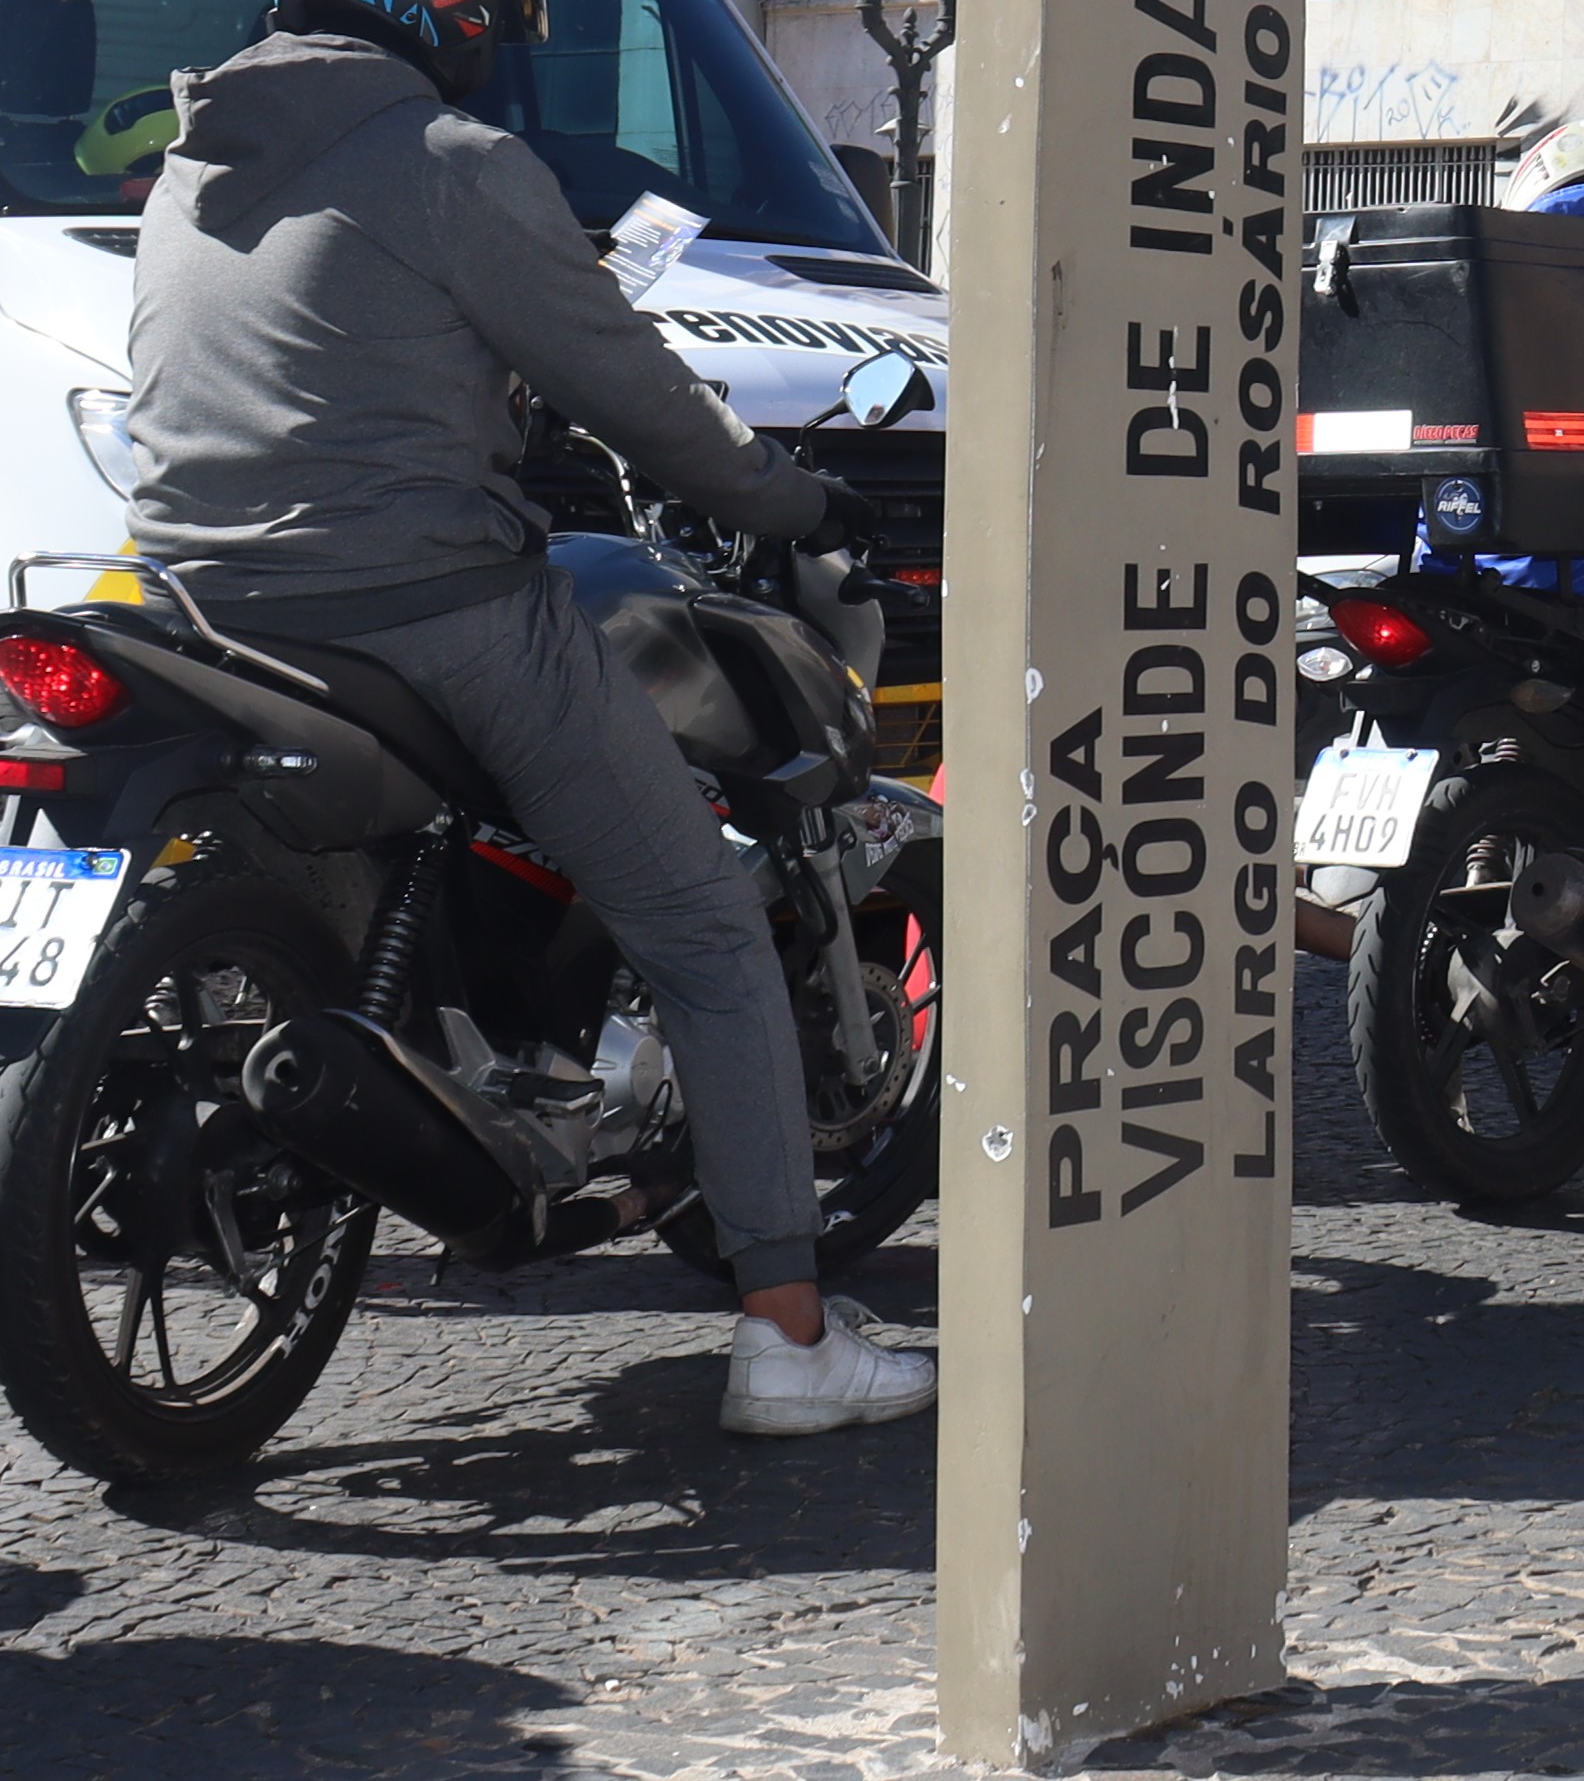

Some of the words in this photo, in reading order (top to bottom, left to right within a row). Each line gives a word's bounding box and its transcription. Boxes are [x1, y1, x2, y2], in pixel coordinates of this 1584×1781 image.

[1223, 4, 1290, 515] ROSÁRIO
[1126, 321, 1211, 478] DE
[1234, 571, 1280, 727] DO
[1120, 563, 1208, 1217] VISCONDE
[1310, 813, 1398, 853] 4H09
[1330, 773, 1401, 810] FVH
[1047, 706, 1118, 1228] PRAÇA
[1233, 781, 1279, 1178] LARGO
